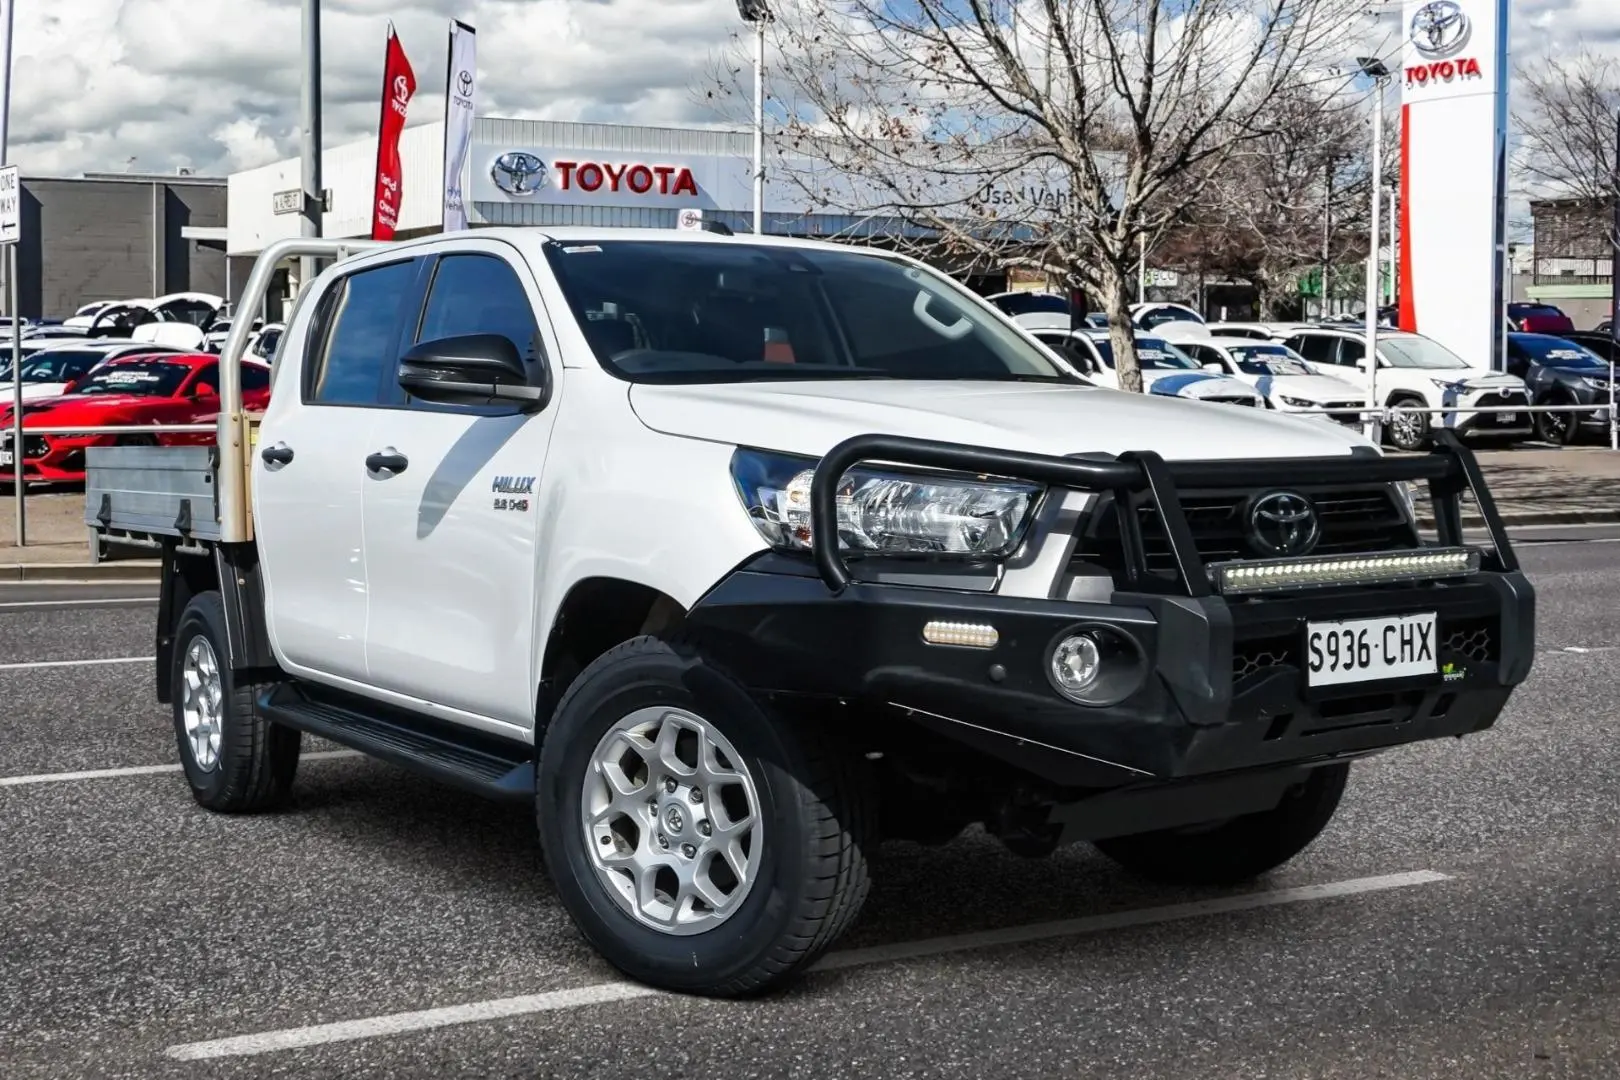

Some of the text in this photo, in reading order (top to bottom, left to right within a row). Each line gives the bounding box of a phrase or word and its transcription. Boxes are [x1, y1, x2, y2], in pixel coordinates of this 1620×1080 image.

[1404, 58, 1481, 83] TOYOTA
[0, 173, 15, 192] ONE
[555, 161, 698, 196] TOYOTA
[0, 196, 16, 214] WAY
[492, 476, 536, 494] HILUX
